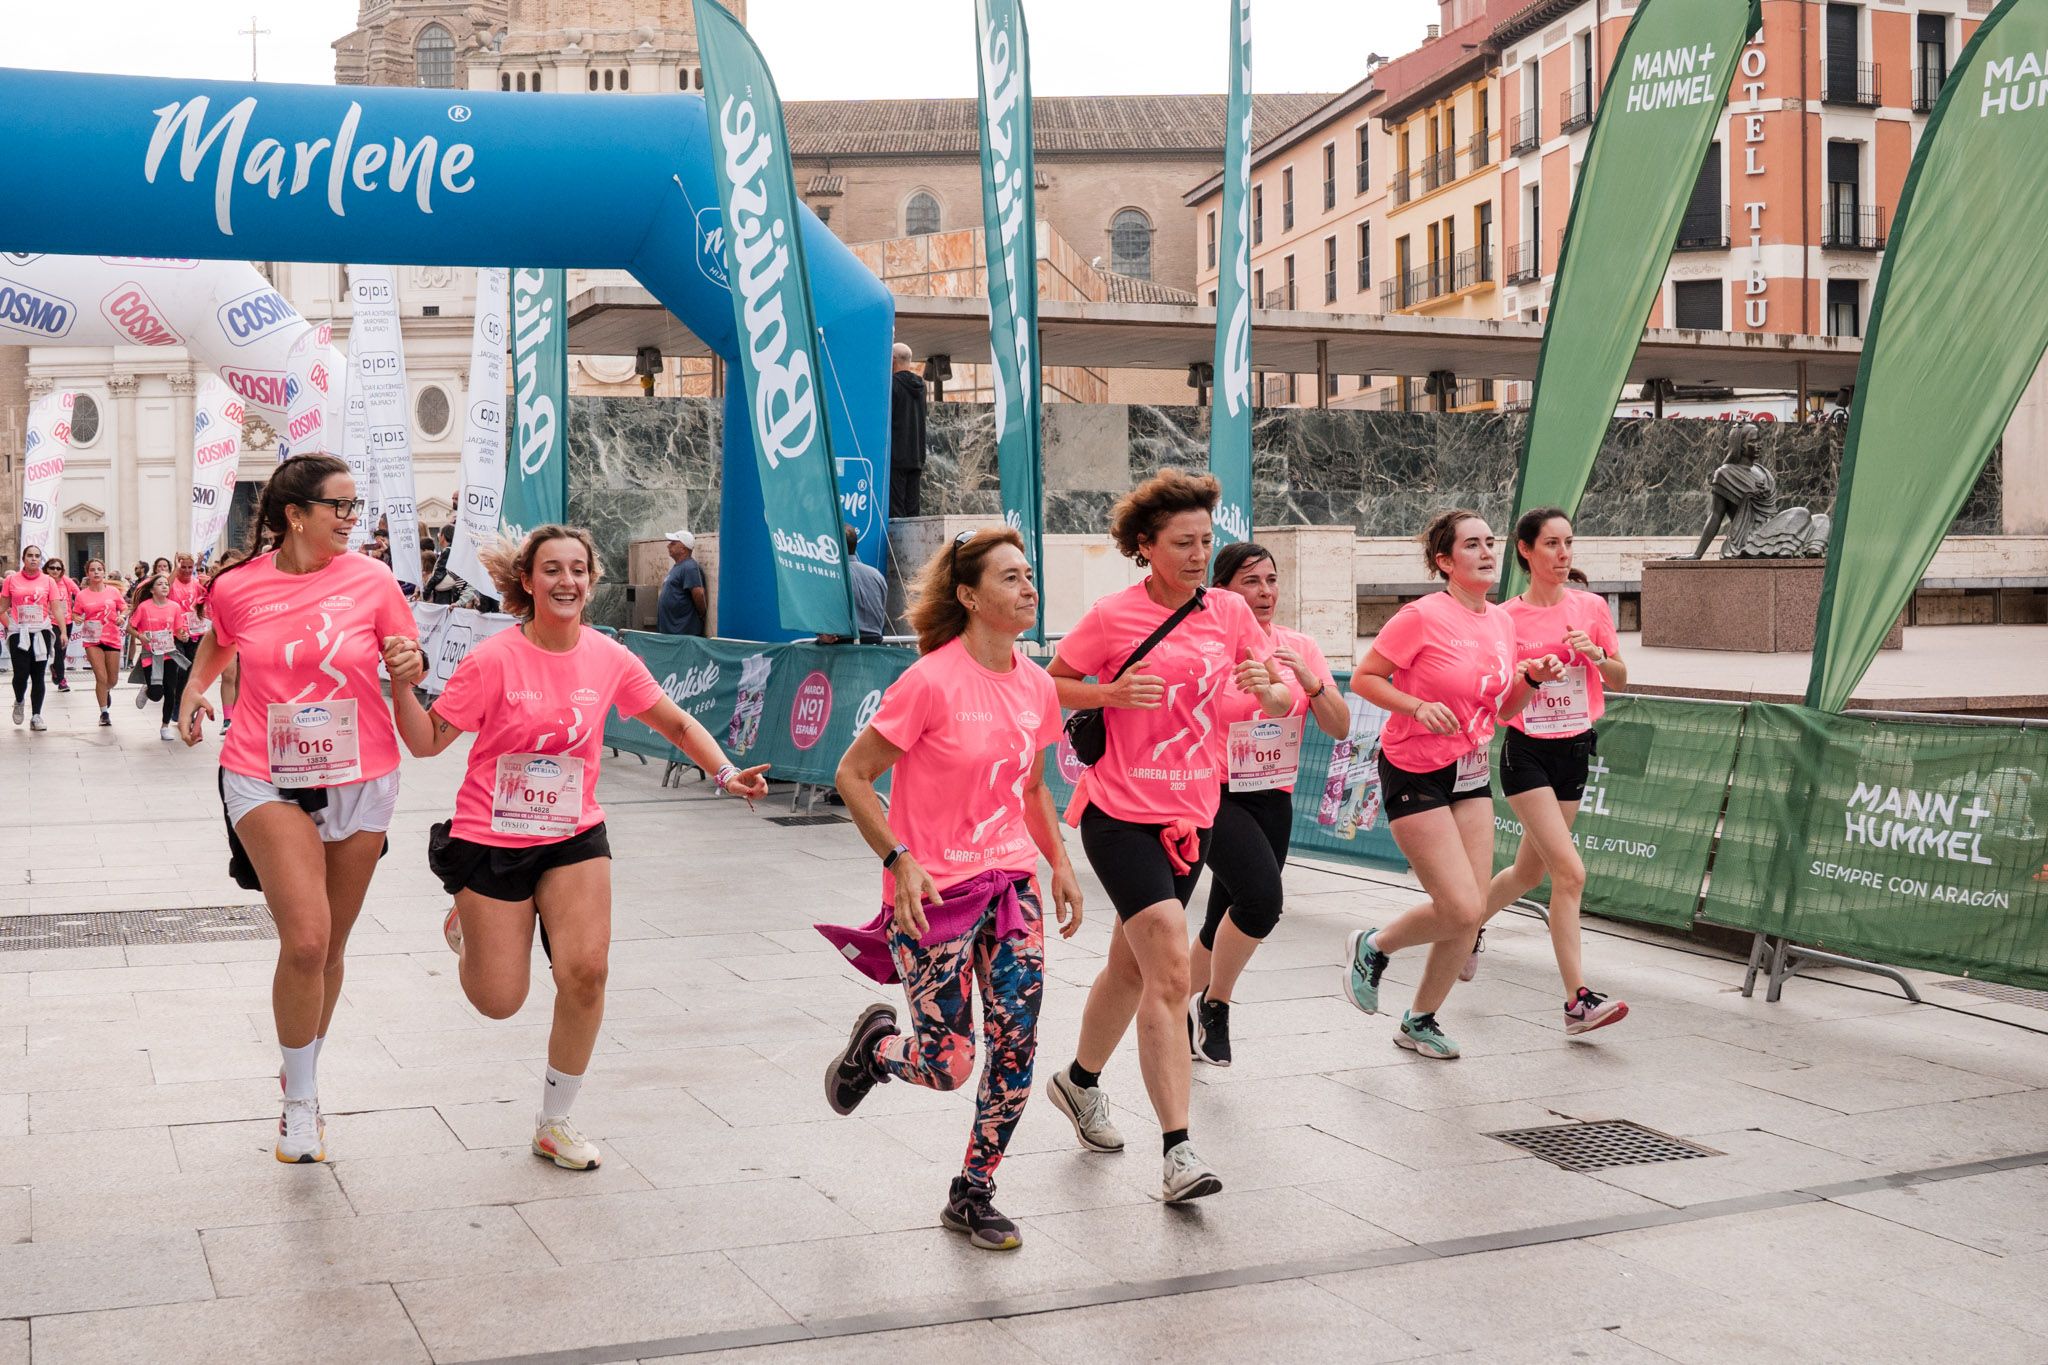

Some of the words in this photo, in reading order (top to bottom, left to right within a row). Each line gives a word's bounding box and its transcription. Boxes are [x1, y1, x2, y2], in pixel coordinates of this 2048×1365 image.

[1626, 74, 1715, 113] HUMMEL
[144, 95, 475, 236] Marlene
[1744, 202, 1767, 328] TIBU
[0, 287, 67, 333] OSMO
[228, 371, 288, 407] COSM
[225, 402, 246, 426] COS
[289, 408, 321, 441] COSMO
[197, 438, 235, 465] COSMO
[28, 457, 64, 482] COSMO
[192, 487, 215, 506] SMO
[23, 501, 43, 520] SMO
[506, 691, 543, 701] OYSHO
[804, 685, 825, 696] MARCA
[1546, 695, 1571, 708] 016
[956, 711, 993, 722] OYSHO
[795, 723, 818, 736] ESPAÑA
[298, 738, 333, 755] 016
[1255, 748, 1281, 763] 016
[1477, 751, 1487, 764] 01
[279, 775, 309, 784] OYSHO
[1128, 767, 1168, 780] CARRERA
[1170, 769, 1181, 781] DE
[1183, 769, 1192, 780] LA
[1170, 782, 1186, 791] 2025
[524, 788, 558, 805] 016
[529, 806, 550, 814] 14828
[501, 821, 529, 830] OYSHO
[1584, 836, 1599, 850] EL
[1601, 838, 1657, 859] FUTURO
[1845, 812, 1993, 866] HUMMEL
[1809, 860, 1884, 890] SIEMPRE
[1888, 876, 1928, 898] CON
[1931, 884, 2009, 909] ARAGÓN
